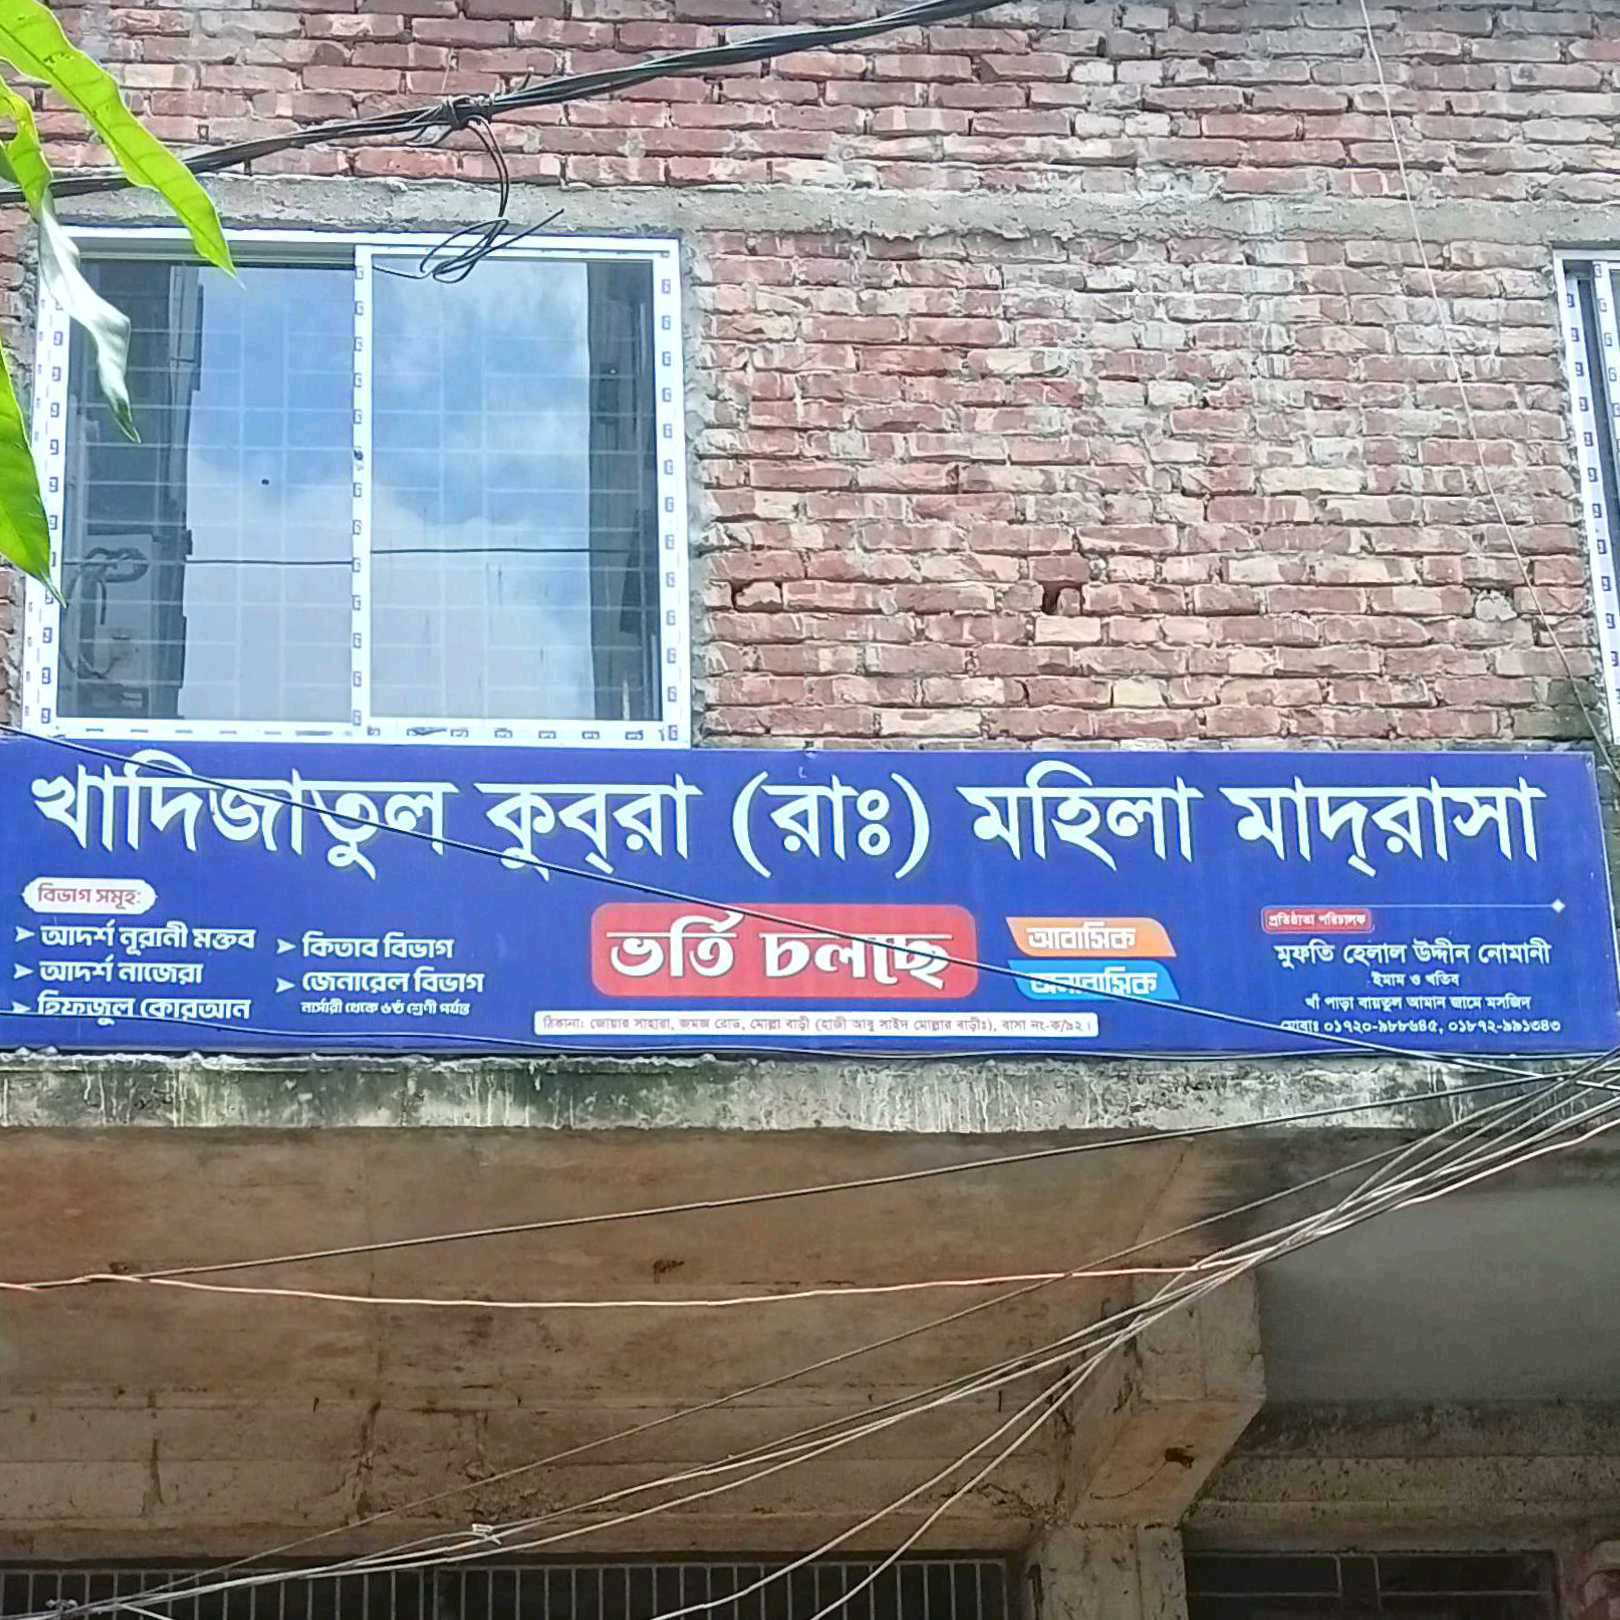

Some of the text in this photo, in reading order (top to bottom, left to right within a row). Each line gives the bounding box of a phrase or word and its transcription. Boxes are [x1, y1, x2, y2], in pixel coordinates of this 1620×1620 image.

[31, 749, 458, 880] খাদিজাতুল
[732, 771, 931, 879] (রাঃ)
[957, 759, 1203, 872] মহিলা
[38, 883, 91, 903] বিভাগ
[40, 919, 256, 956] আদর্শ নূরানী মক্তব
[302, 930, 455, 958] কিতাব বিভাগ
[1026, 921, 1137, 949] আবাসিক
[606, 910, 953, 989] ভর্তি চলছে
[1273, 938, 1552, 968] মুফতি হেলাল উদ্দীন নোমানী
[39, 954, 204, 985] আদর্শ নাজেরা
[302, 966, 485, 994] জেনারেল বিভাগ
[1371, 970, 1460, 987] ইমাম ও খতিব
[140, 998, 251, 1021] কোরআন
[345, 1001, 379, 1014] থেকে
[1406, 996, 1446, 1010] আমান
[1450, 996, 1482, 1010] জামে
[1485, 992, 1532, 1010] মসজিদ
